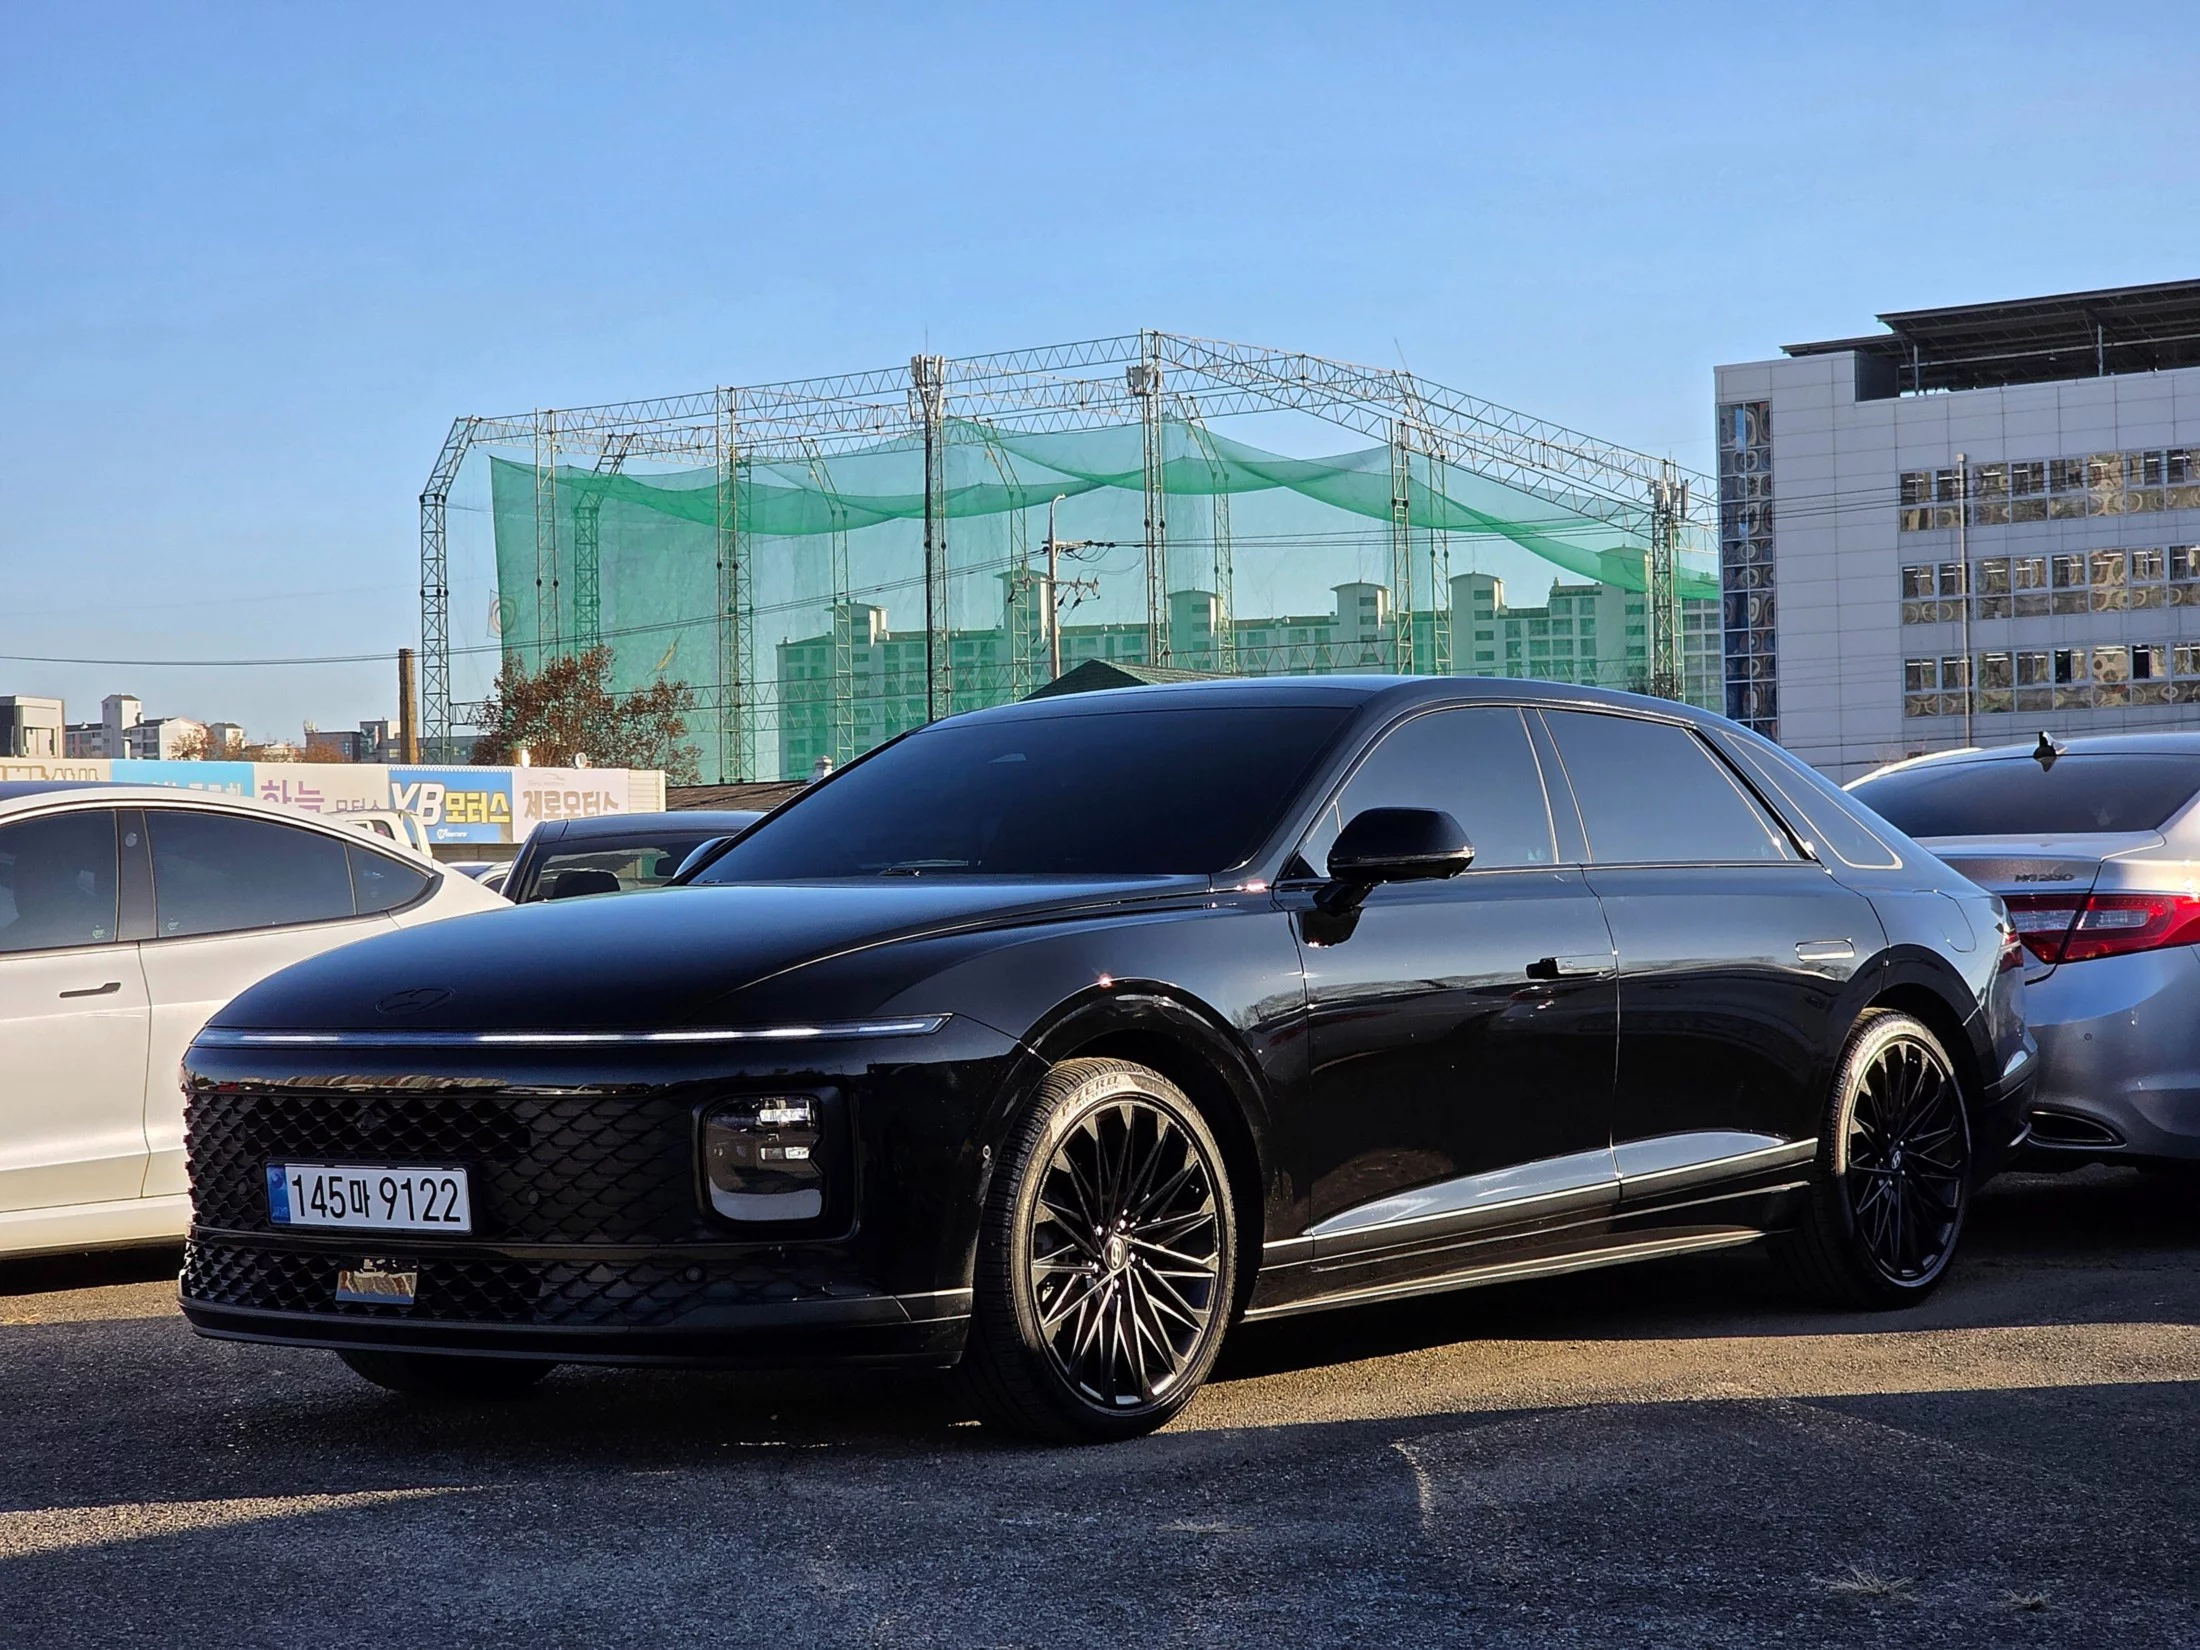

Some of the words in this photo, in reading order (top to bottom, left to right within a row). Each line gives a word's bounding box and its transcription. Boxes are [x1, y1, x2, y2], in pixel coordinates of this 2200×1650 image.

[261, 780, 325, 813] 하늘
[391, 782, 446, 826] VB
[445, 792, 511, 824] 모터스
[1061, 1102, 1070, 1117] P
[1074, 1075, 1118, 1104] ZERO
[291, 1174, 370, 1219] 145마
[379, 1176, 461, 1223] 9122
